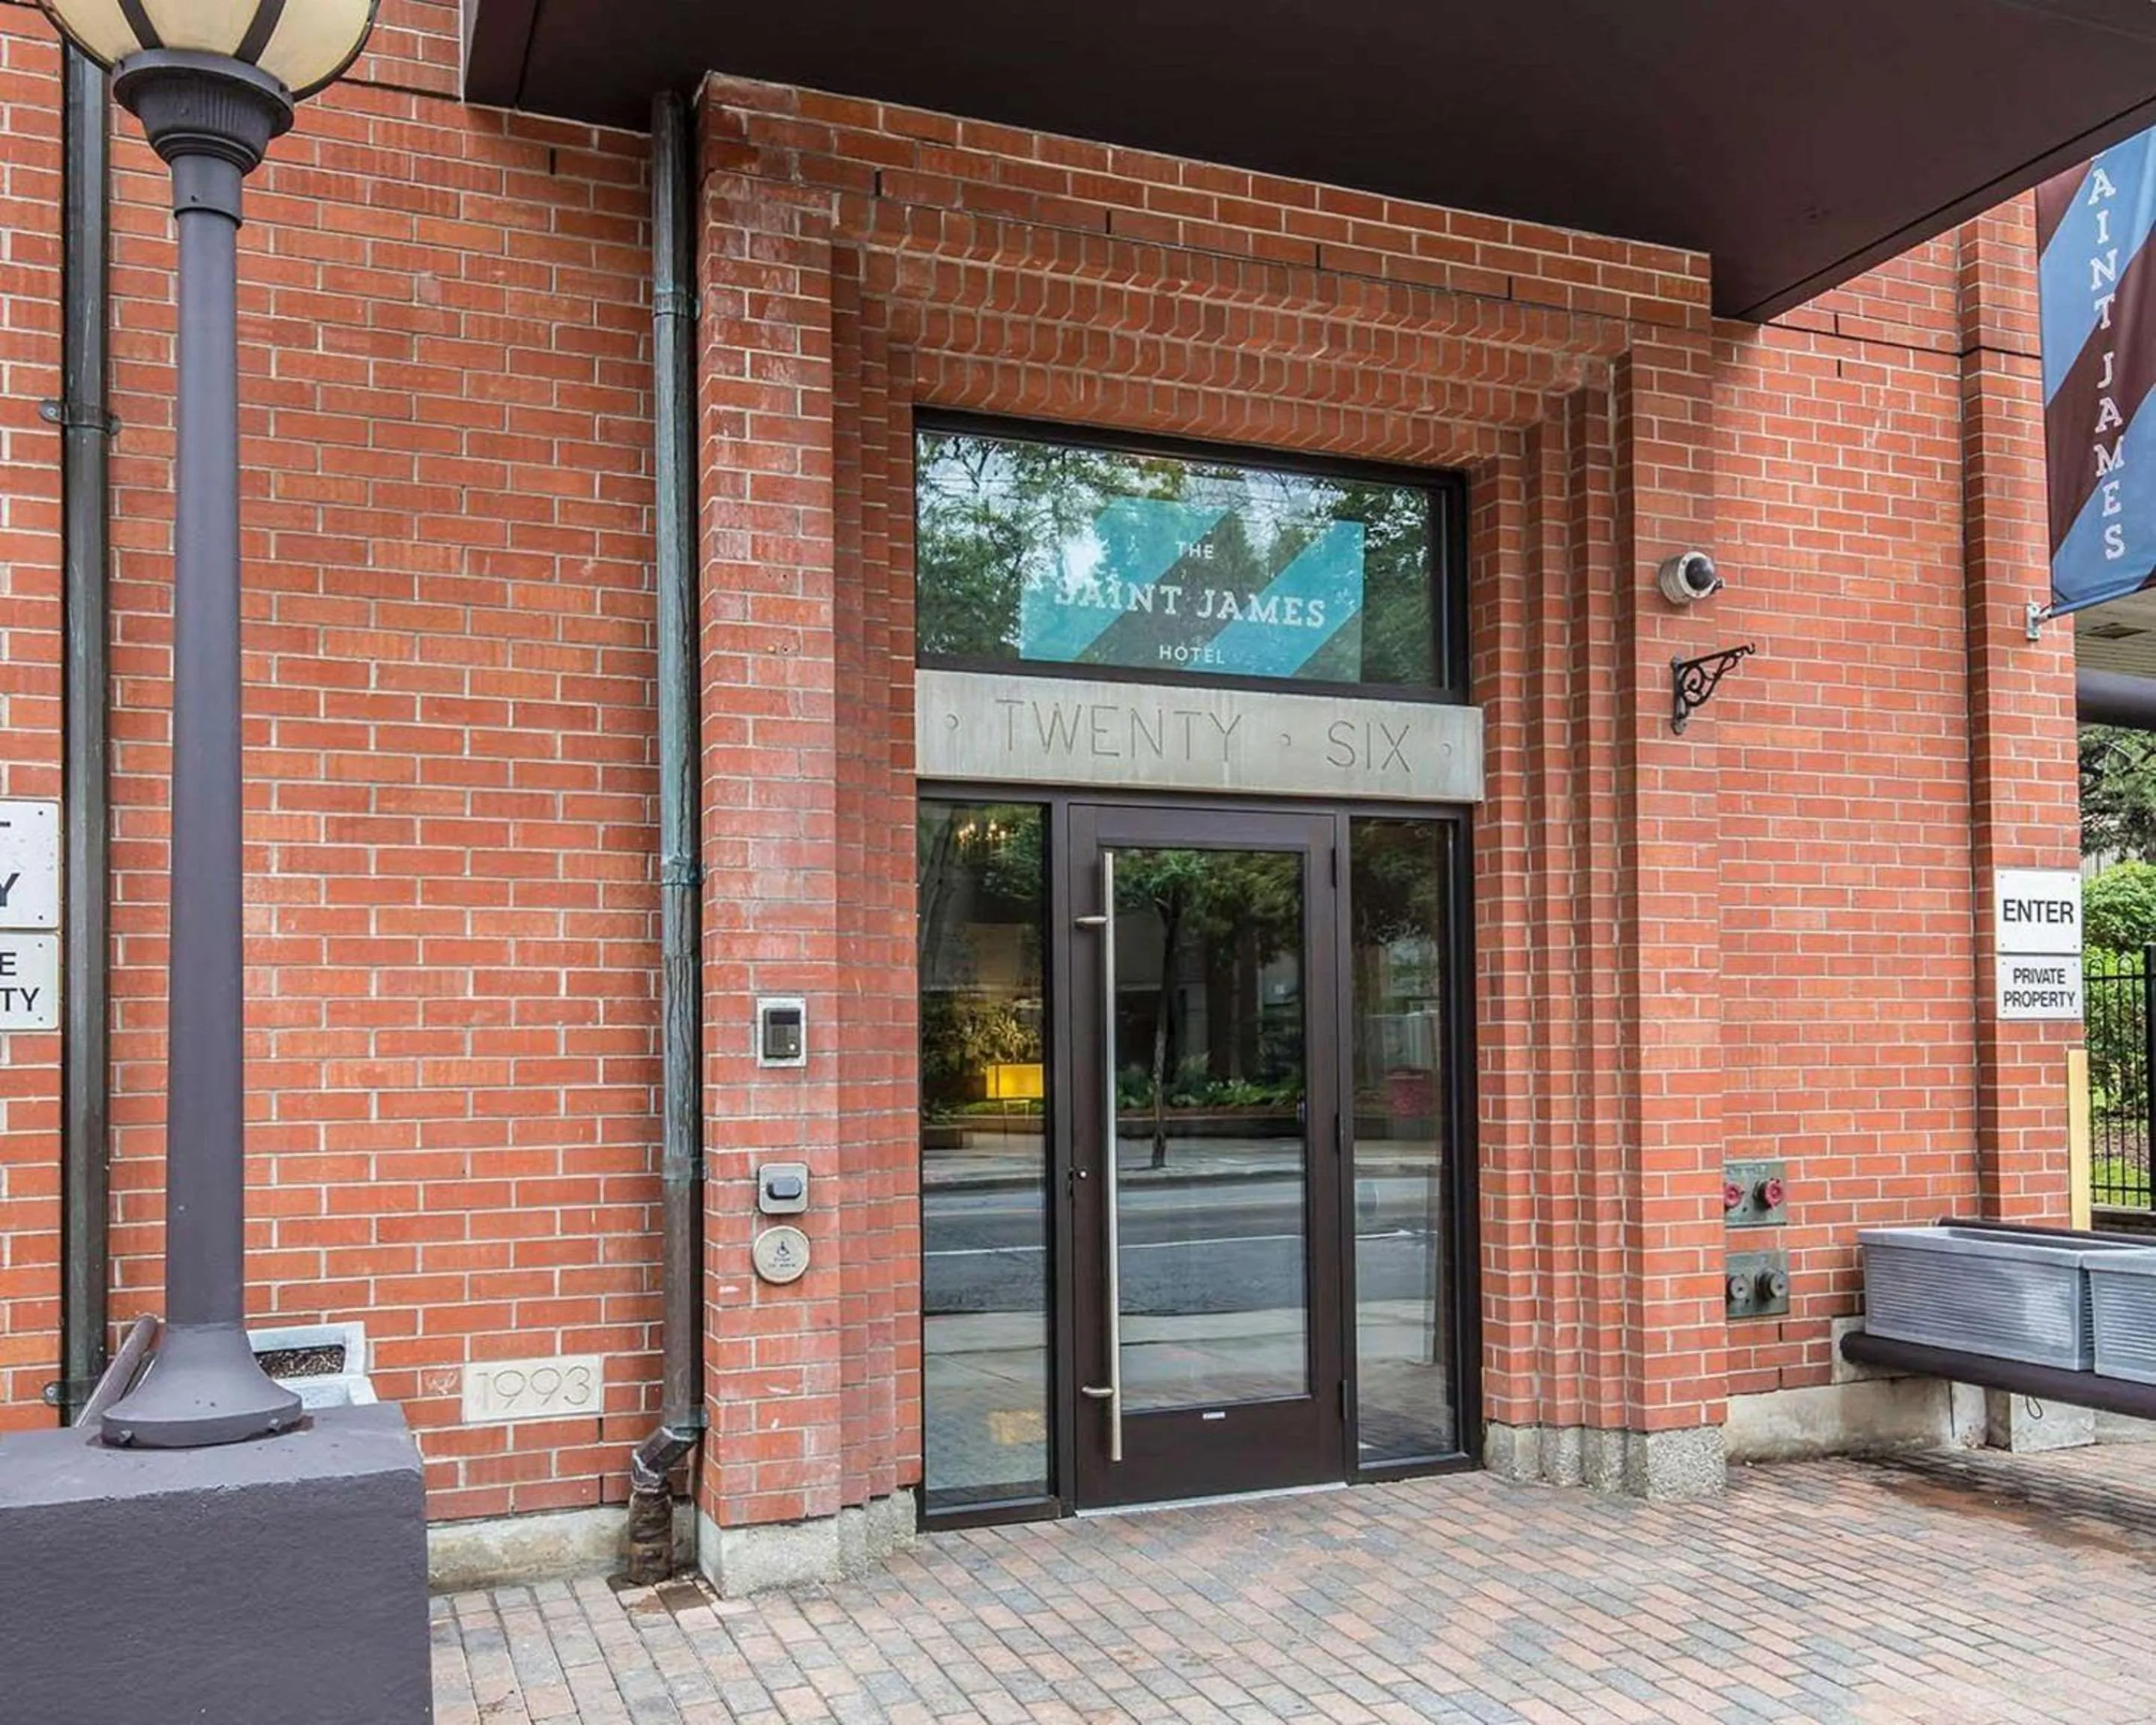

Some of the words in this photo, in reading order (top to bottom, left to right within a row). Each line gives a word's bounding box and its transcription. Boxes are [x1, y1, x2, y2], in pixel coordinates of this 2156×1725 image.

[2089, 151, 2118, 330] AINT
[2095, 352, 2126, 559] JAMES
[1175, 540, 1214, 560] THE
[1197, 588, 1326, 628] JAMES
[1159, 645, 1225, 665] HOTEL
[996, 699, 1242, 761] TWENTY
[1327, 720, 1413, 773] SIX
[2003, 899, 2074, 924] ENTER
[2013, 967, 2066, 985] PRIVATE
[2003, 991, 2076, 1007] PROPERTY
[475, 1366, 591, 1410] 1993
